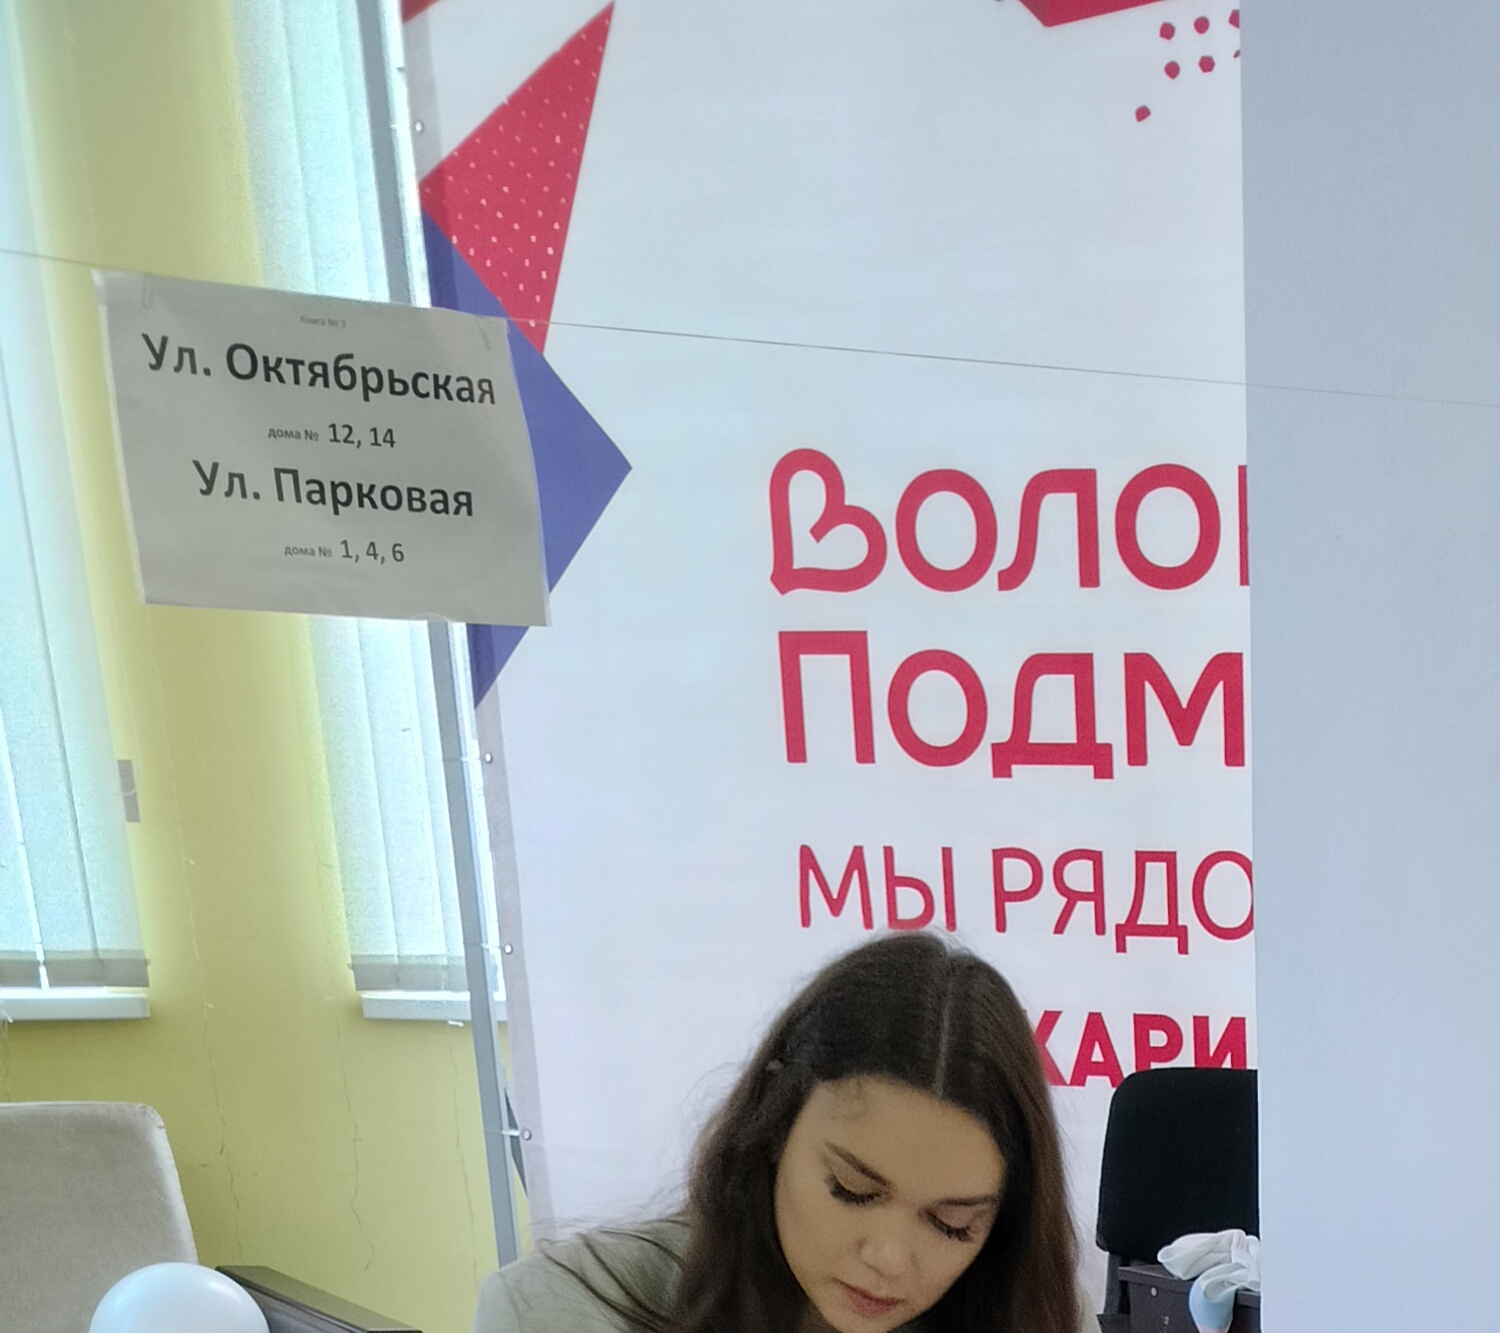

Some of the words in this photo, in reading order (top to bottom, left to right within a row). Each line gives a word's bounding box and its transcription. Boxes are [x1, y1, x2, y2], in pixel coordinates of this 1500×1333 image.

[141, 332, 211, 376] Ул.
[226, 343, 496, 405] Октябрьская
[267, 427, 301, 440] дома
[304, 429, 319, 442] №
[328, 423, 362, 449] 12,
[369, 427, 396, 448] 14
[192, 459, 260, 500] Ул.
[273, 467, 474, 517] Парковая
[284, 545, 315, 557] дома
[317, 546, 332, 558] №
[340, 540, 360, 563] 1,
[366, 541, 386, 565] 4,
[391, 543, 405, 563] 6
[798, 844, 957, 933] МЫ
[991, 847, 1254, 955] РЯДО
